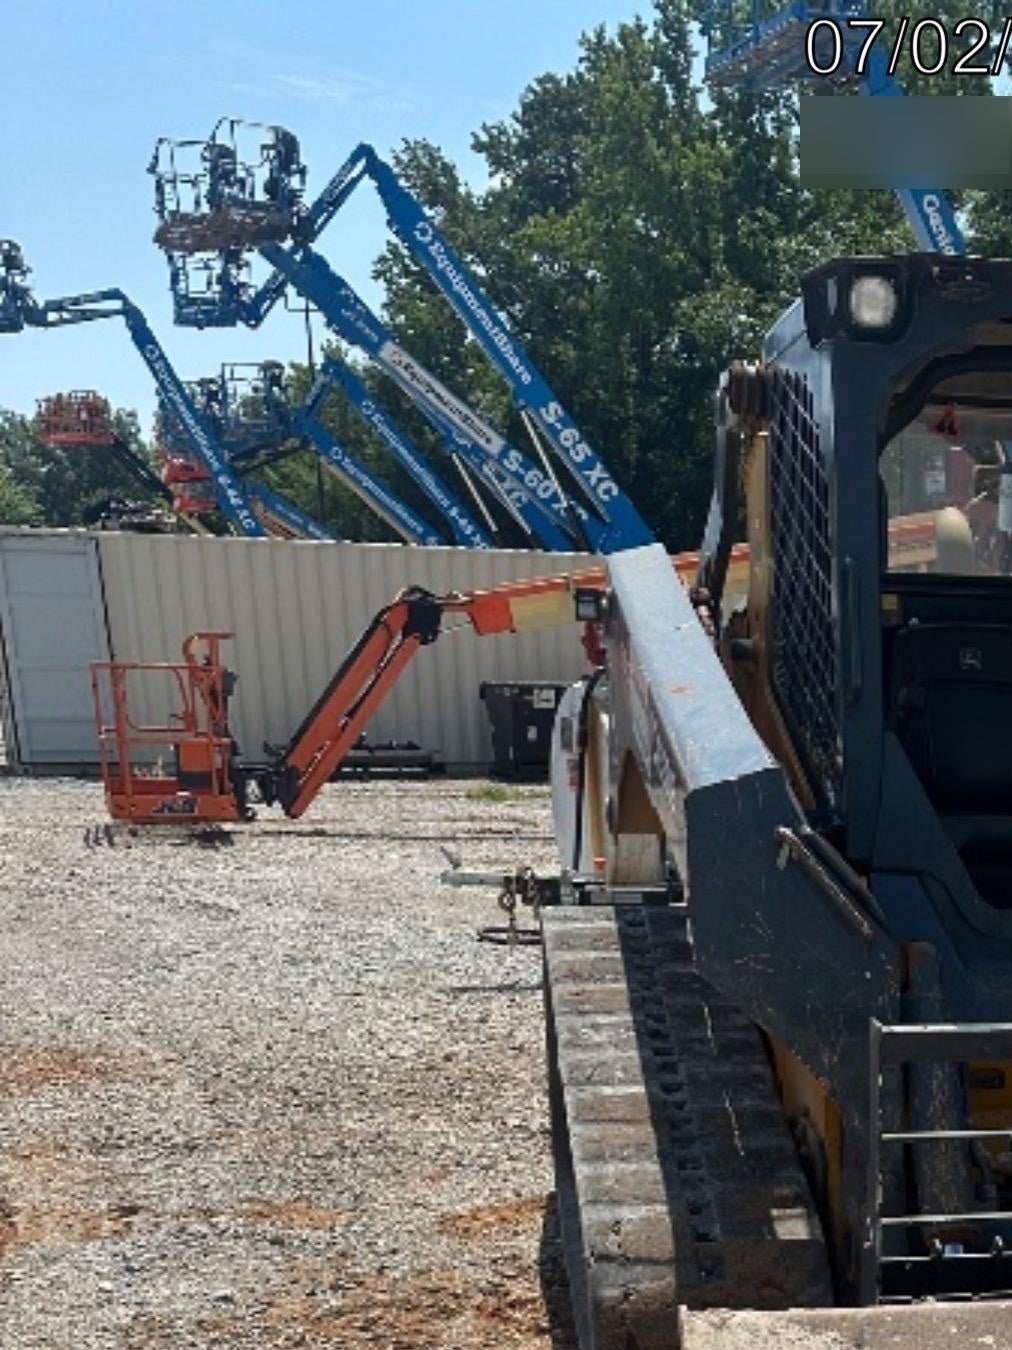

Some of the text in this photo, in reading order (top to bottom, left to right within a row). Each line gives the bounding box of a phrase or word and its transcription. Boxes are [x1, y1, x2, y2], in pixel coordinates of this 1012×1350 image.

[399, 361, 493, 445] EquipmentShare
[503, 449, 556, 499] S-60
[428, 241, 532, 385] EquipmentShare
[539, 401, 592, 463] S-65
[582, 461, 619, 502] XC
